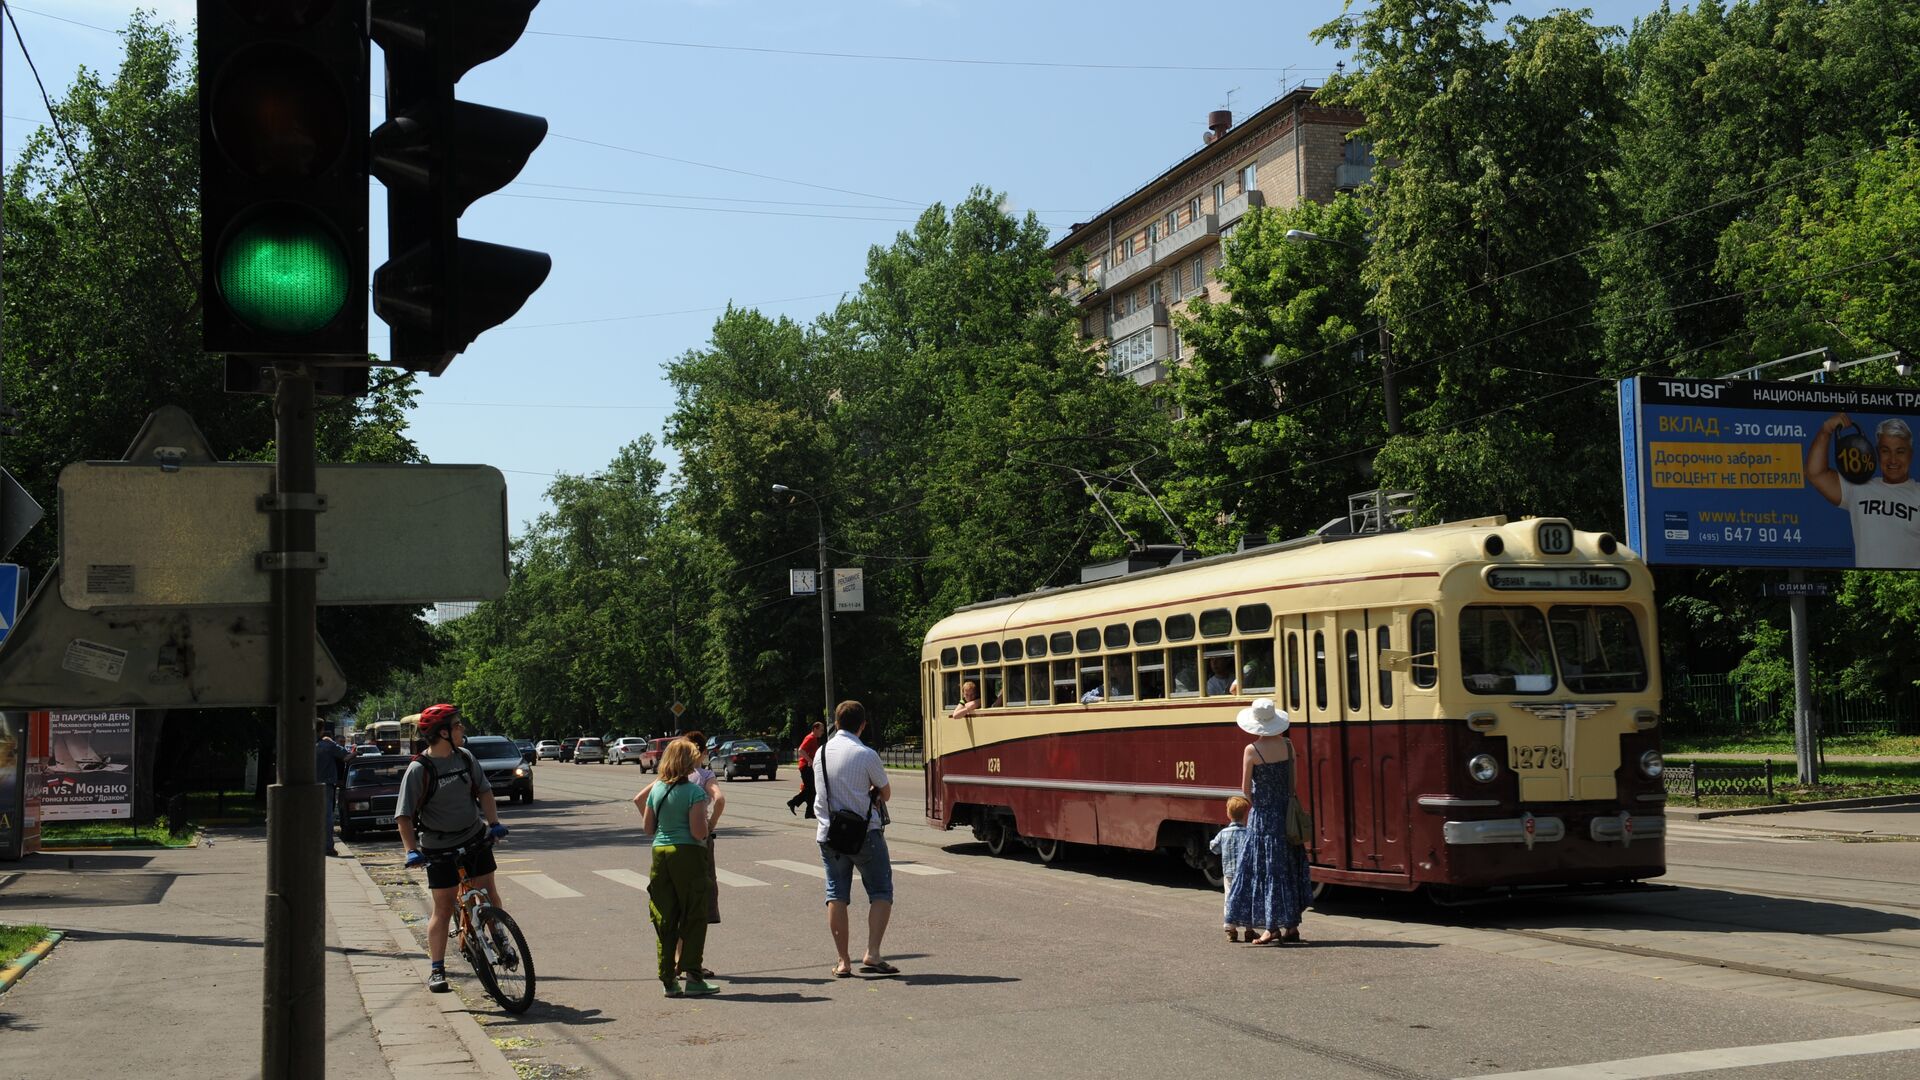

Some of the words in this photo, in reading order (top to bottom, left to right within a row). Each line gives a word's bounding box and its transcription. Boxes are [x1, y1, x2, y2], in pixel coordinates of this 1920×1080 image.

[1658, 381, 1726, 399] TRUST
[1752, 388, 1858, 406] НАЦИОНАЛЬНЫЙ
[1861, 392, 1894, 407] БАНК
[1895, 392, 1920, 408] ТРА
[1658, 416, 1720, 437] ВКЛАД
[1734, 422, 1761, 436] это
[1765, 424, 1807, 438] сила.
[1654, 450, 1723, 467] Досрочно
[1727, 451, 1772, 467] забрал
[1838, 447, 1875, 474] 18%
[1655, 471, 1719, 486] ПРОЦЕНТ
[1721, 473, 1737, 484] НЕ
[1740, 472, 1802, 485] ПОТЕРЯЛ!
[1698, 508, 1799, 525] www.trust.ru
[1858, 500, 1918, 522] TRUST
[1543, 528, 1563, 550] 18
[1698, 532, 1720, 543] (495)
[1723, 527, 1752, 543] 647
[1758, 528, 1777, 543] 90
[1783, 529, 1802, 543] 44
[1778, 583, 1814, 591] ОЛИМП
[61, 712, 107, 721] ПАРУСНЫЙ
[108, 713, 130, 722] ДЕНЬ
[1512, 745, 1564, 769] 1278
[1175, 761, 1196, 781] 1278
[53, 786, 72, 795] vs.
[76, 783, 127, 794] Монако
[95, 794, 129, 802] "Дракон"
